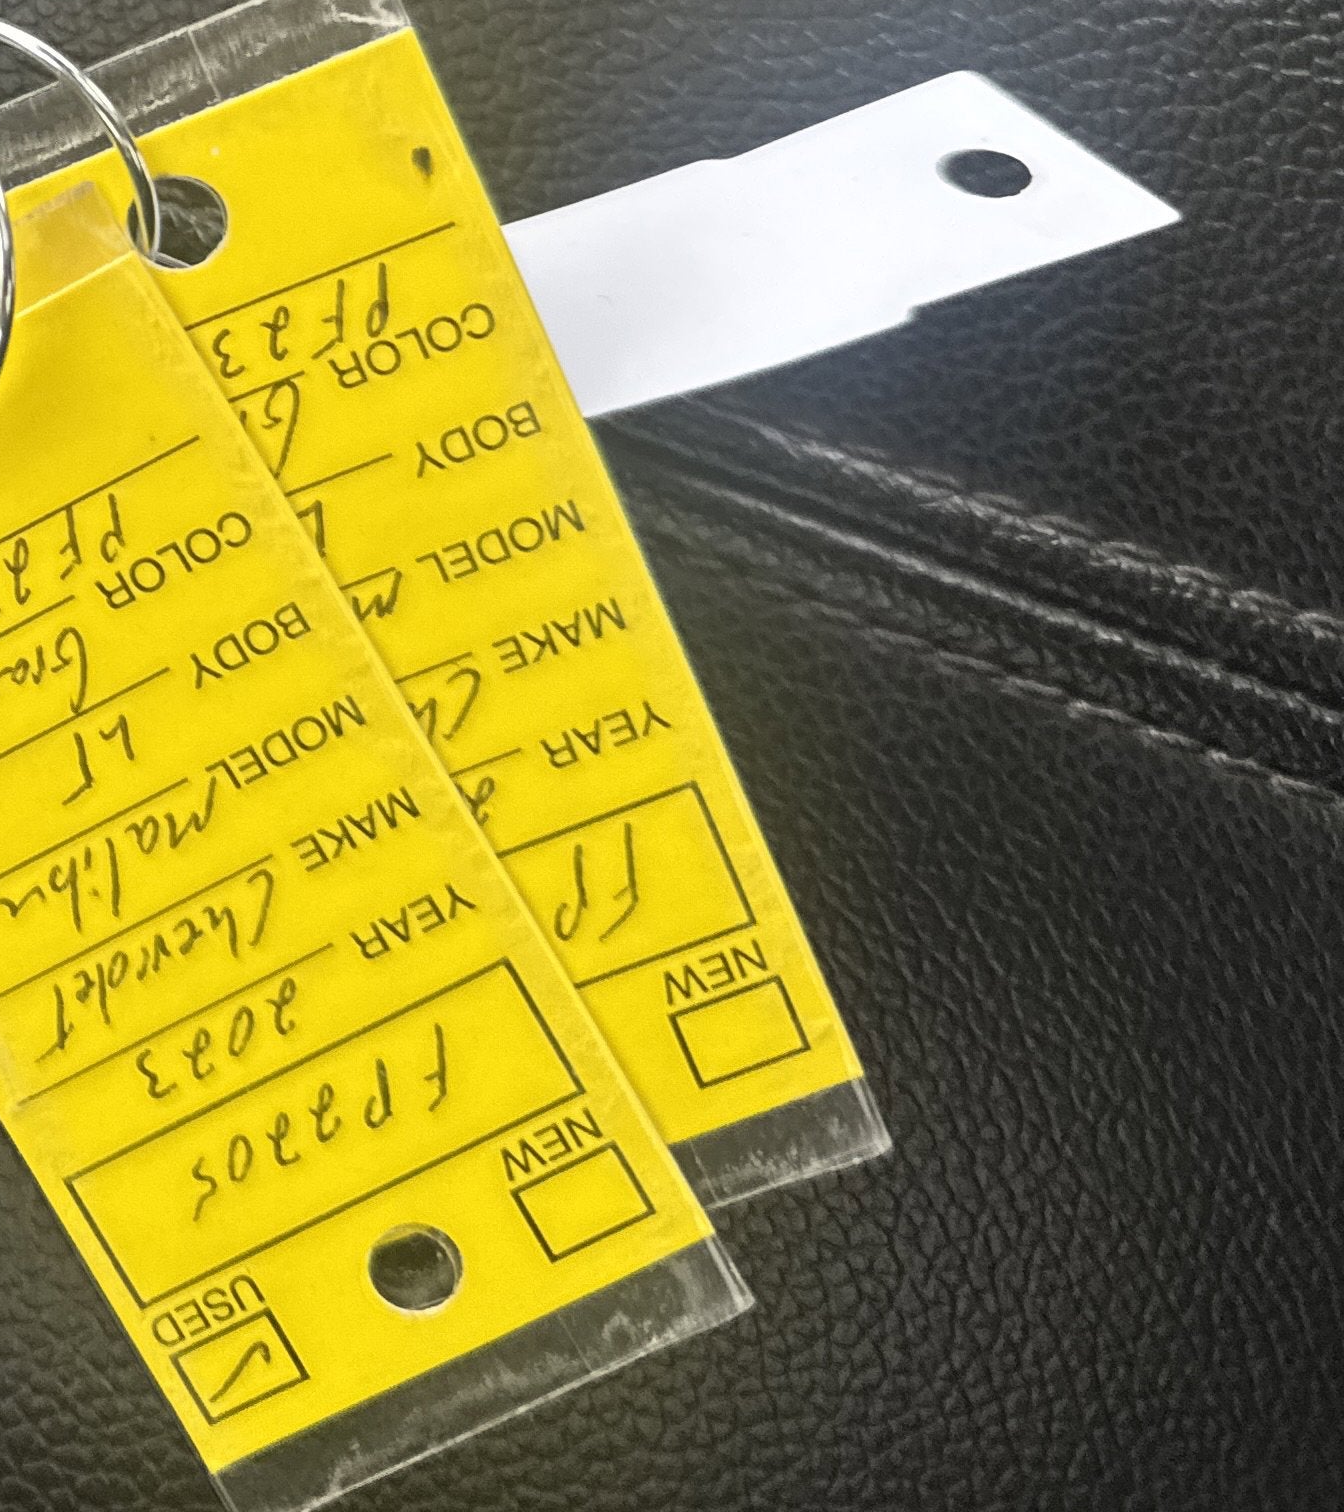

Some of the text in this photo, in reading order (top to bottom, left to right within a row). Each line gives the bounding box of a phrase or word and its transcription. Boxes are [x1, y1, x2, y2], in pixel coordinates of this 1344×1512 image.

[328, 303, 496, 389] COLOR
[415, 400, 542, 479] BODY
[95, 510, 254, 611] COLOR
[415, 498, 586, 584] MODEL
[189, 600, 312, 691] BODY
[492, 597, 628, 674] MAKE
[206, 694, 368, 793] MODEL
[540, 699, 672, 769] YEAR
[290, 787, 422, 873] MAKE
[349, 883, 478, 961] YEAR
[663, 938, 770, 1006] NEW
[136, 977, 300, 1100] 2023
[192, 1022, 449, 1222] FP2205
[500, 1106, 603, 1182] NEW
[152, 1274, 266, 1348] USED
